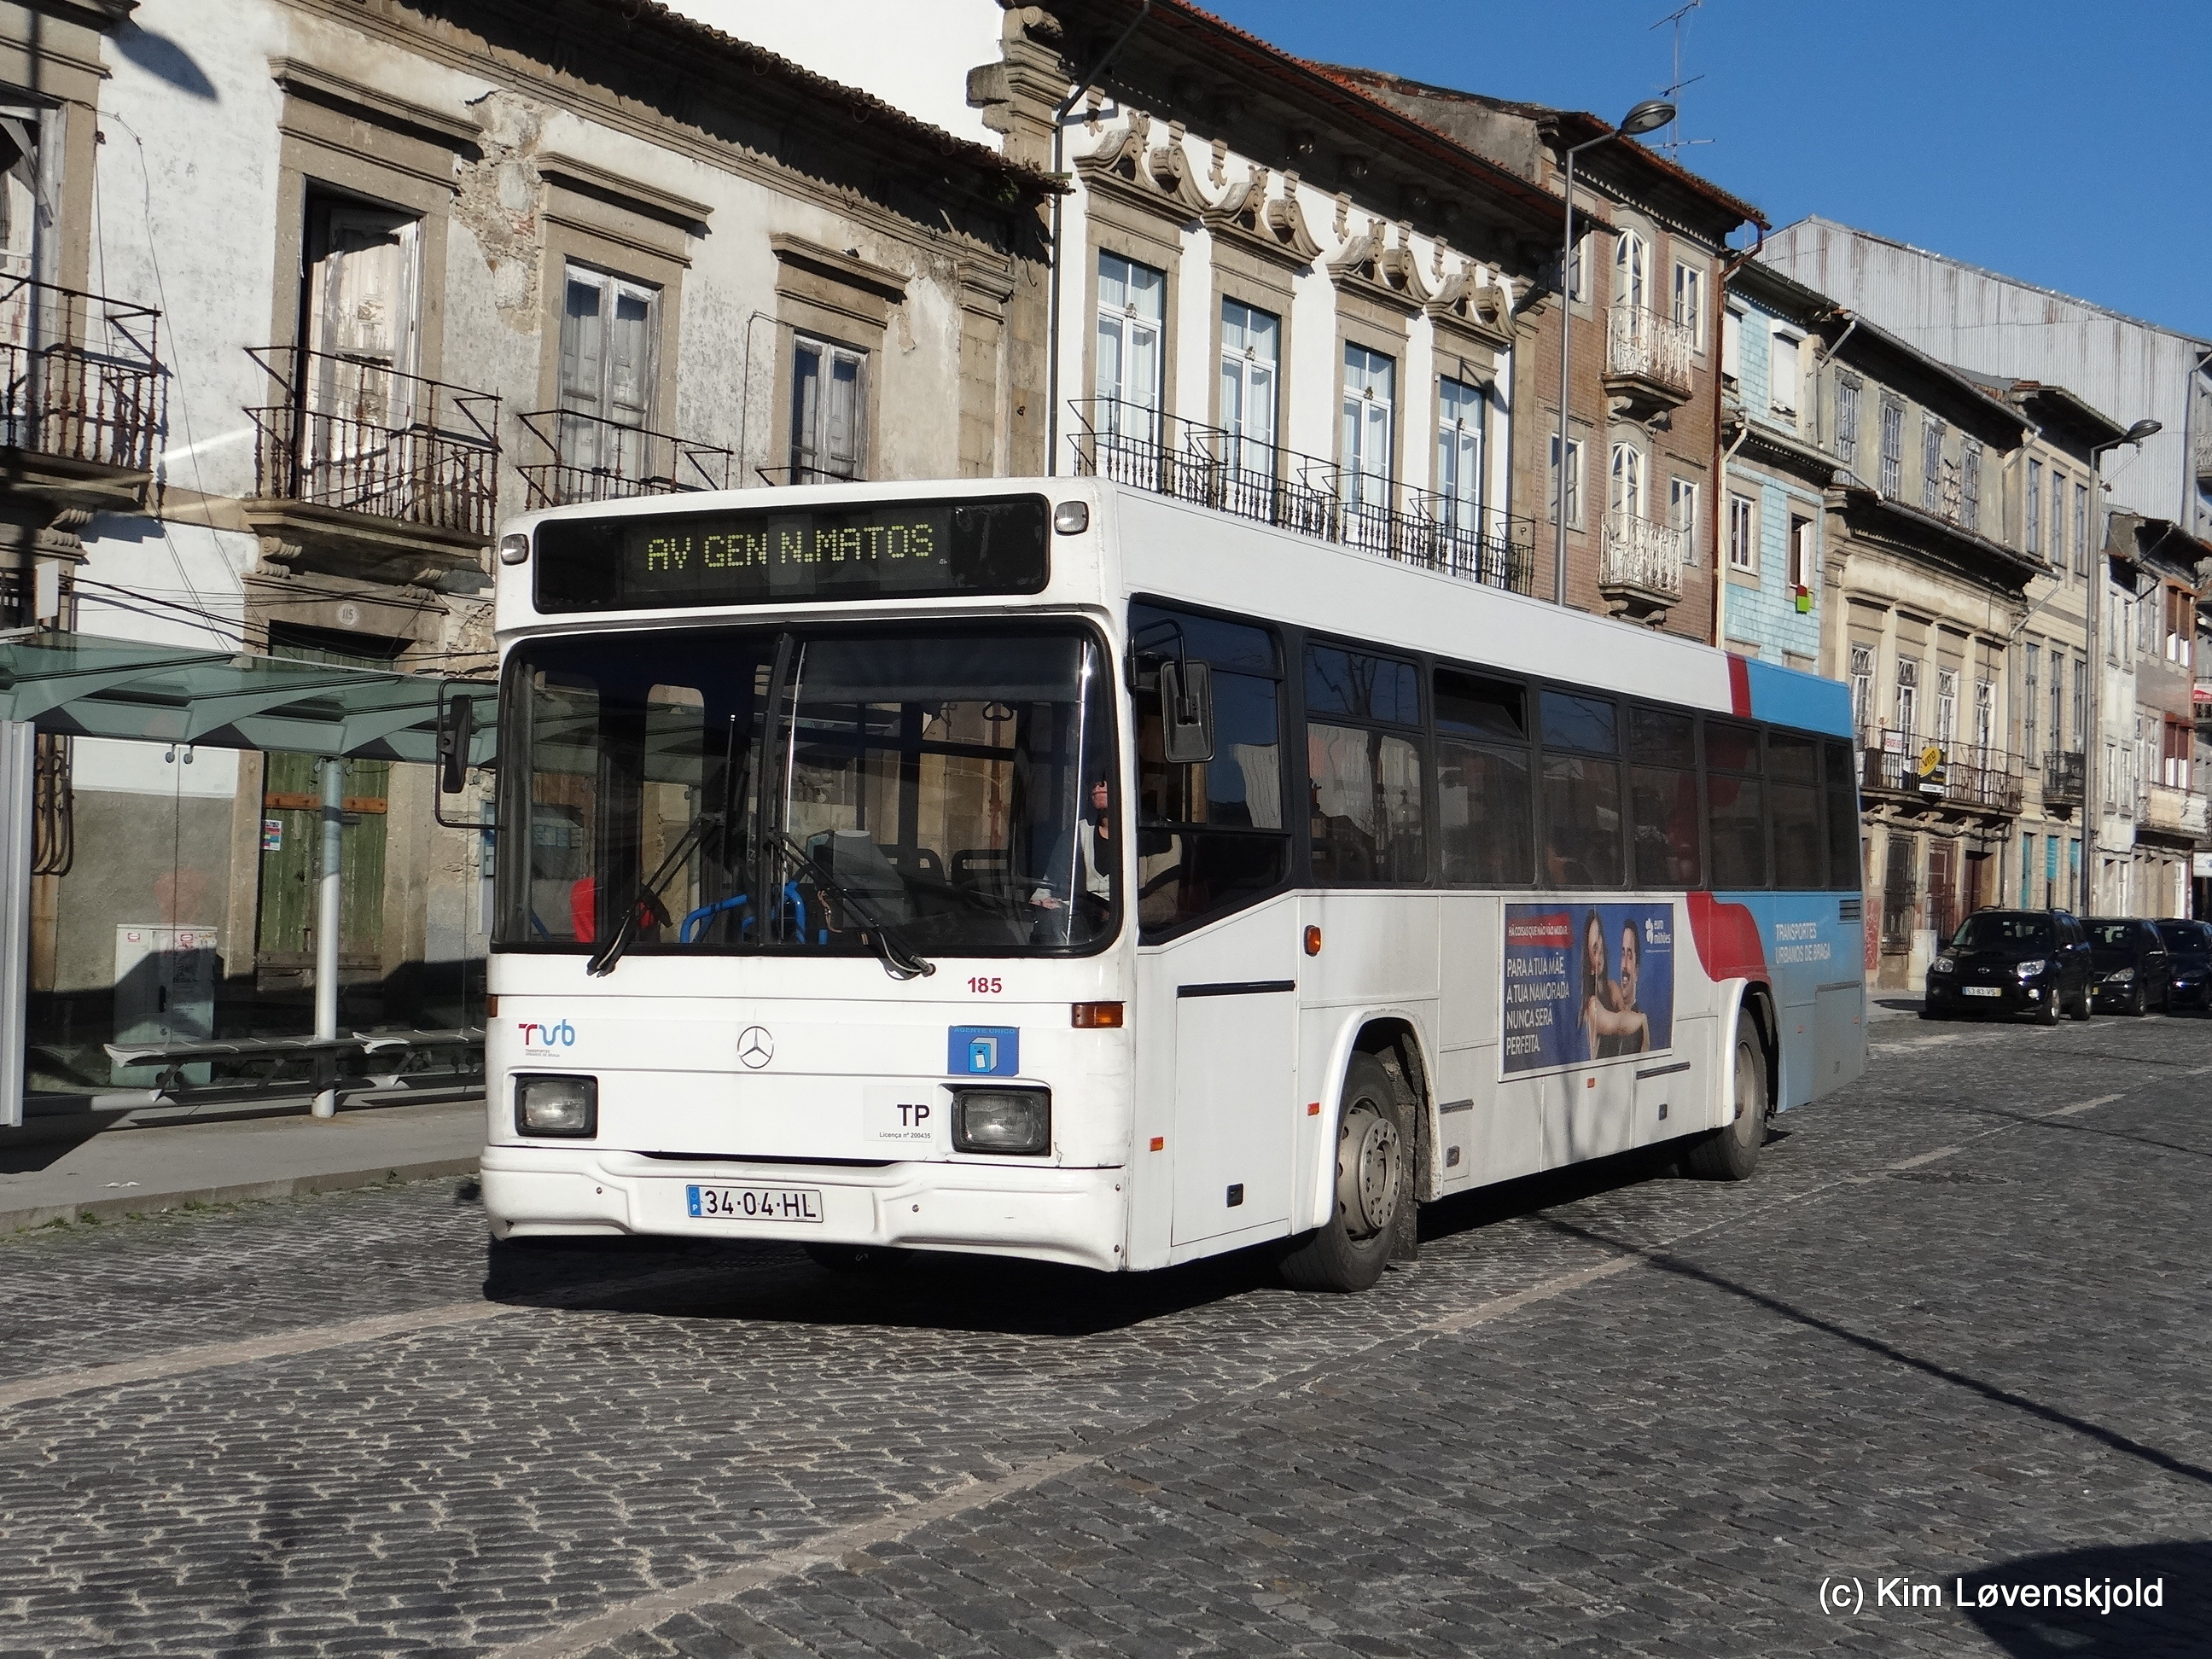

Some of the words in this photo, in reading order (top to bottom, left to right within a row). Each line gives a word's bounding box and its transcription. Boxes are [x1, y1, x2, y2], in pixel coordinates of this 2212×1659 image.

[649, 537, 691, 571] AV
[705, 533, 767, 568] GEN
[342, 608, 354, 620] 115
[1775, 923, 1817, 940] TRANSPORTES
[1804, 944, 1813, 962] DE
[1506, 958, 1528, 978] PARA
[1528, 958, 1534, 976] A
[1534, 957, 1548, 976] TUA
[967, 977, 1003, 993] 185
[1506, 984, 1513, 1004] A
[1513, 983, 1529, 1003] TUA
[1529, 981, 1570, 1002] NAMORADA
[1506, 1009, 1535, 1029] NUNCA
[1535, 1002, 1553, 1027] SERÁ
[1506, 1034, 1540, 1056] PERFEITA.
[897, 1104, 930, 1126] TP
